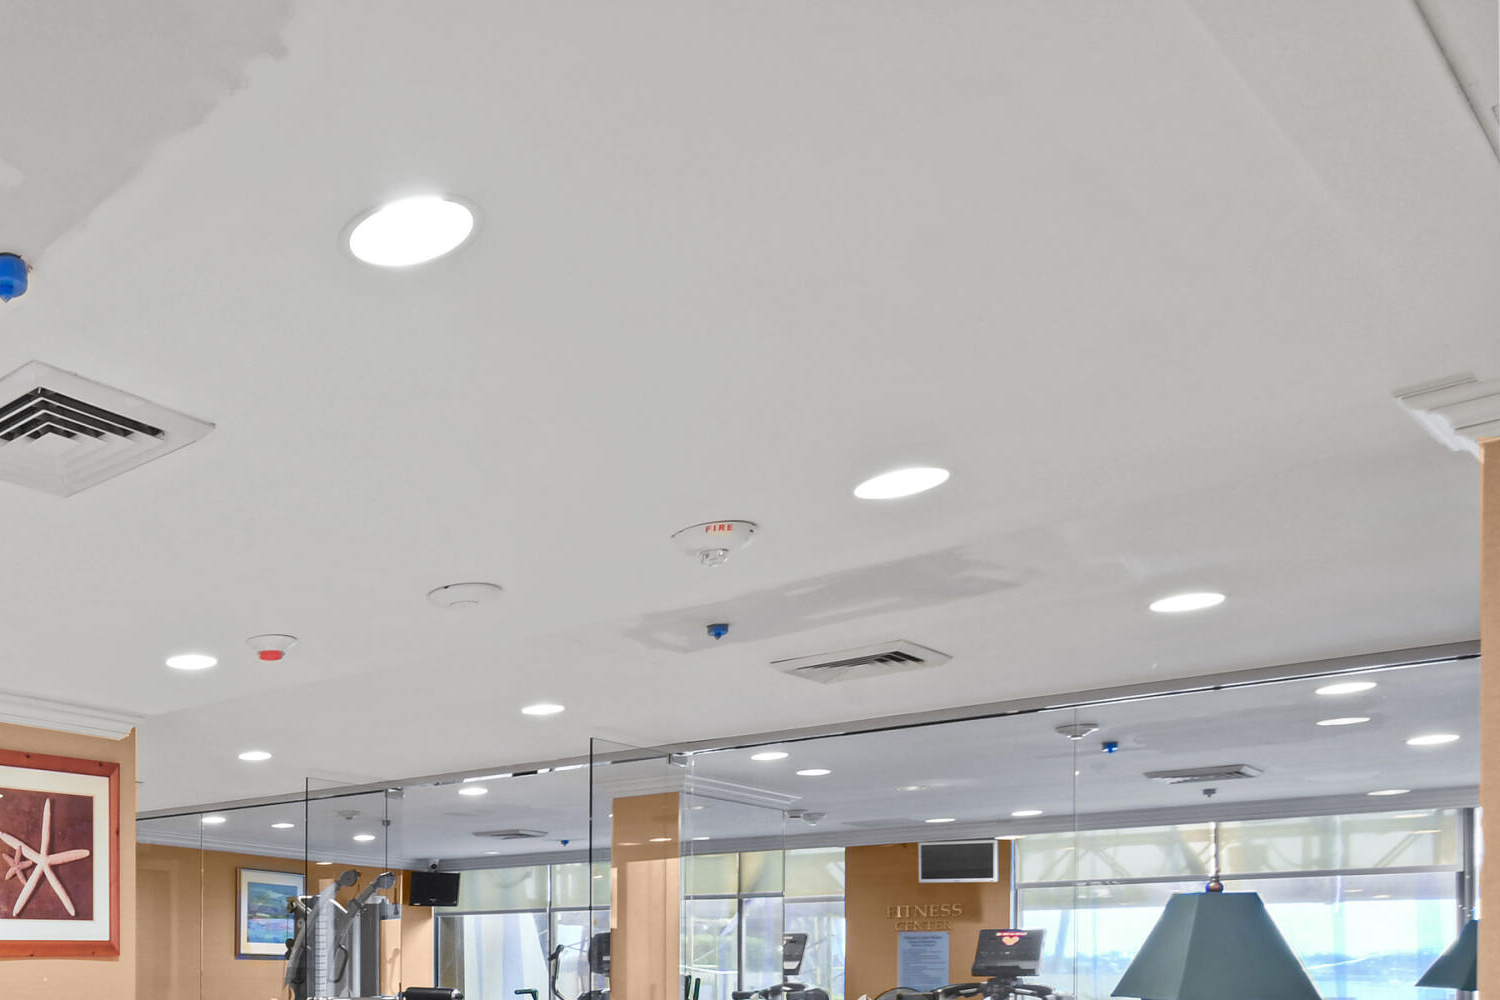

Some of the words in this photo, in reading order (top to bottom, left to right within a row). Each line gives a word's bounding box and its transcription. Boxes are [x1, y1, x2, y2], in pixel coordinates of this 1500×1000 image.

[705, 523, 733, 533] FIRE
[886, 903, 963, 919] FITNESS
[895, 920, 953, 931] CENTER
